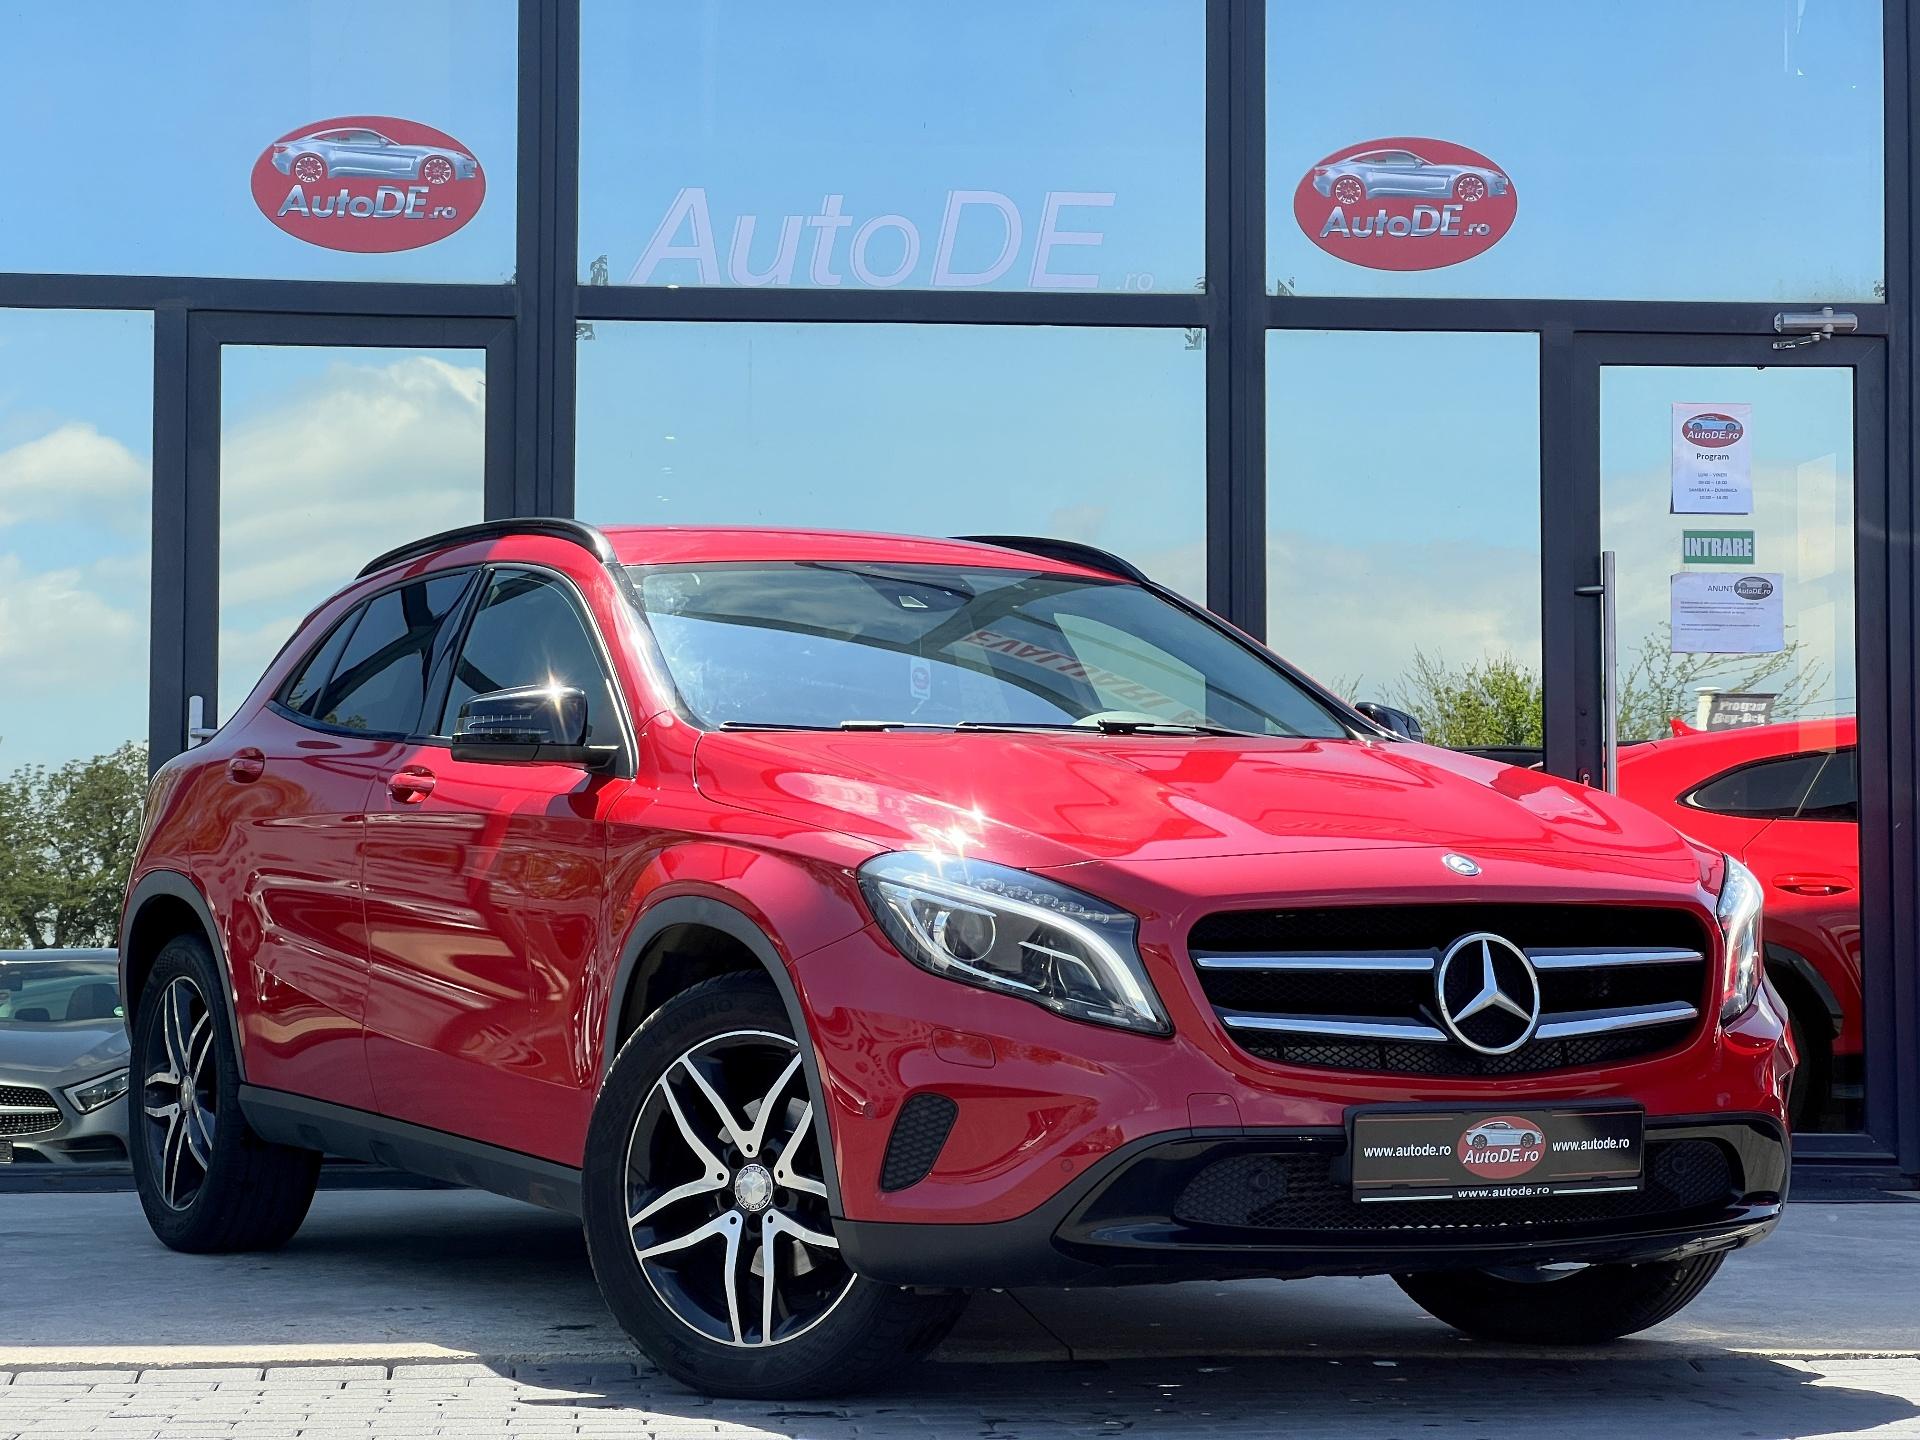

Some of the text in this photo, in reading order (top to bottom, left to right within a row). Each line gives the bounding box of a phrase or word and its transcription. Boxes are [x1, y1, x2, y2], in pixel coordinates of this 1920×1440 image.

[1687, 430, 1739, 439] AutoDE.ro
[1696, 453, 1729, 461] Program
[1684, 538, 1752, 557] INTRARE
[1737, 587, 1771, 595] AutoDE.ro
[1364, 1143, 1451, 1157] www.autode.ro
[1552, 1138, 1630, 1152] www.autode.ro
[1463, 1148, 1540, 1165] AutoDE.ro
[1457, 1186, 1550, 1198] www.autode.ro
